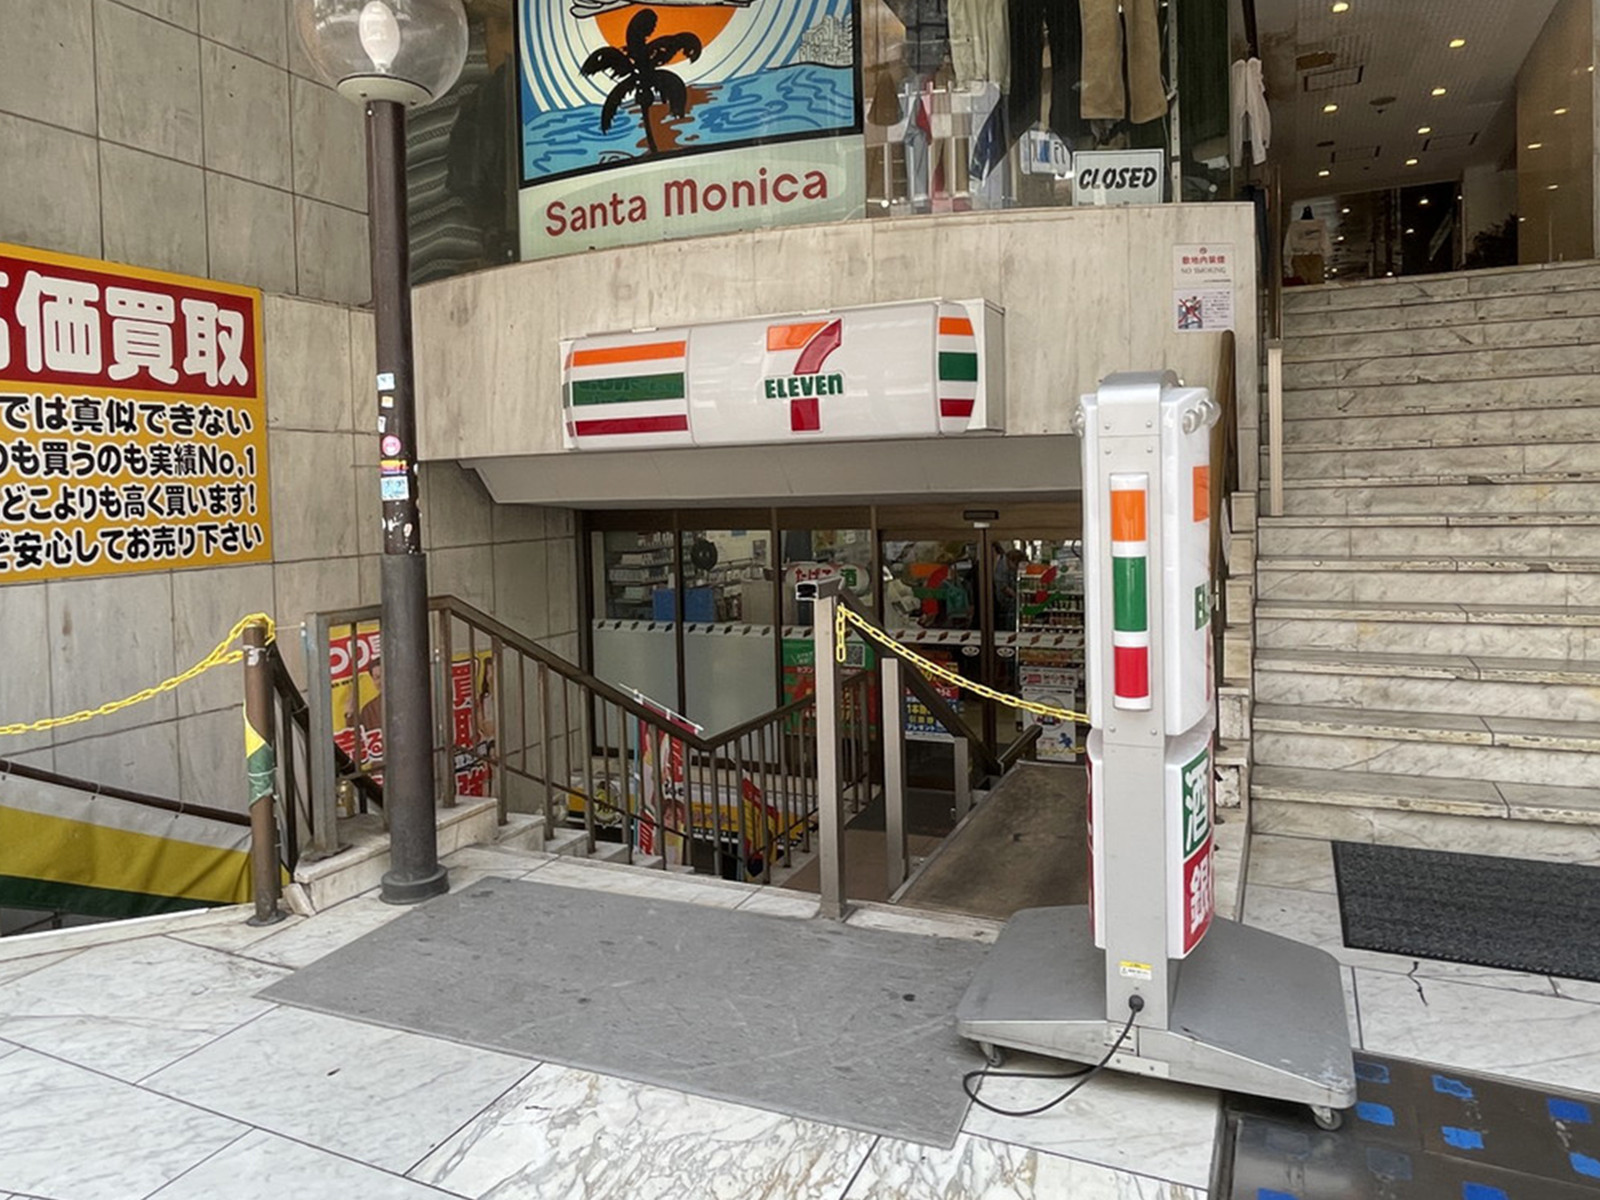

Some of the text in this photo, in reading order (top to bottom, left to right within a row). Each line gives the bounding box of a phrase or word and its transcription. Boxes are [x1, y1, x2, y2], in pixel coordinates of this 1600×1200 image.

[1079, 167, 1157, 190] CLOSED
[545, 192, 647, 237] Santa
[0, 395, 251, 436] では真似できない
[1185, 757, 1209, 851] 酒
